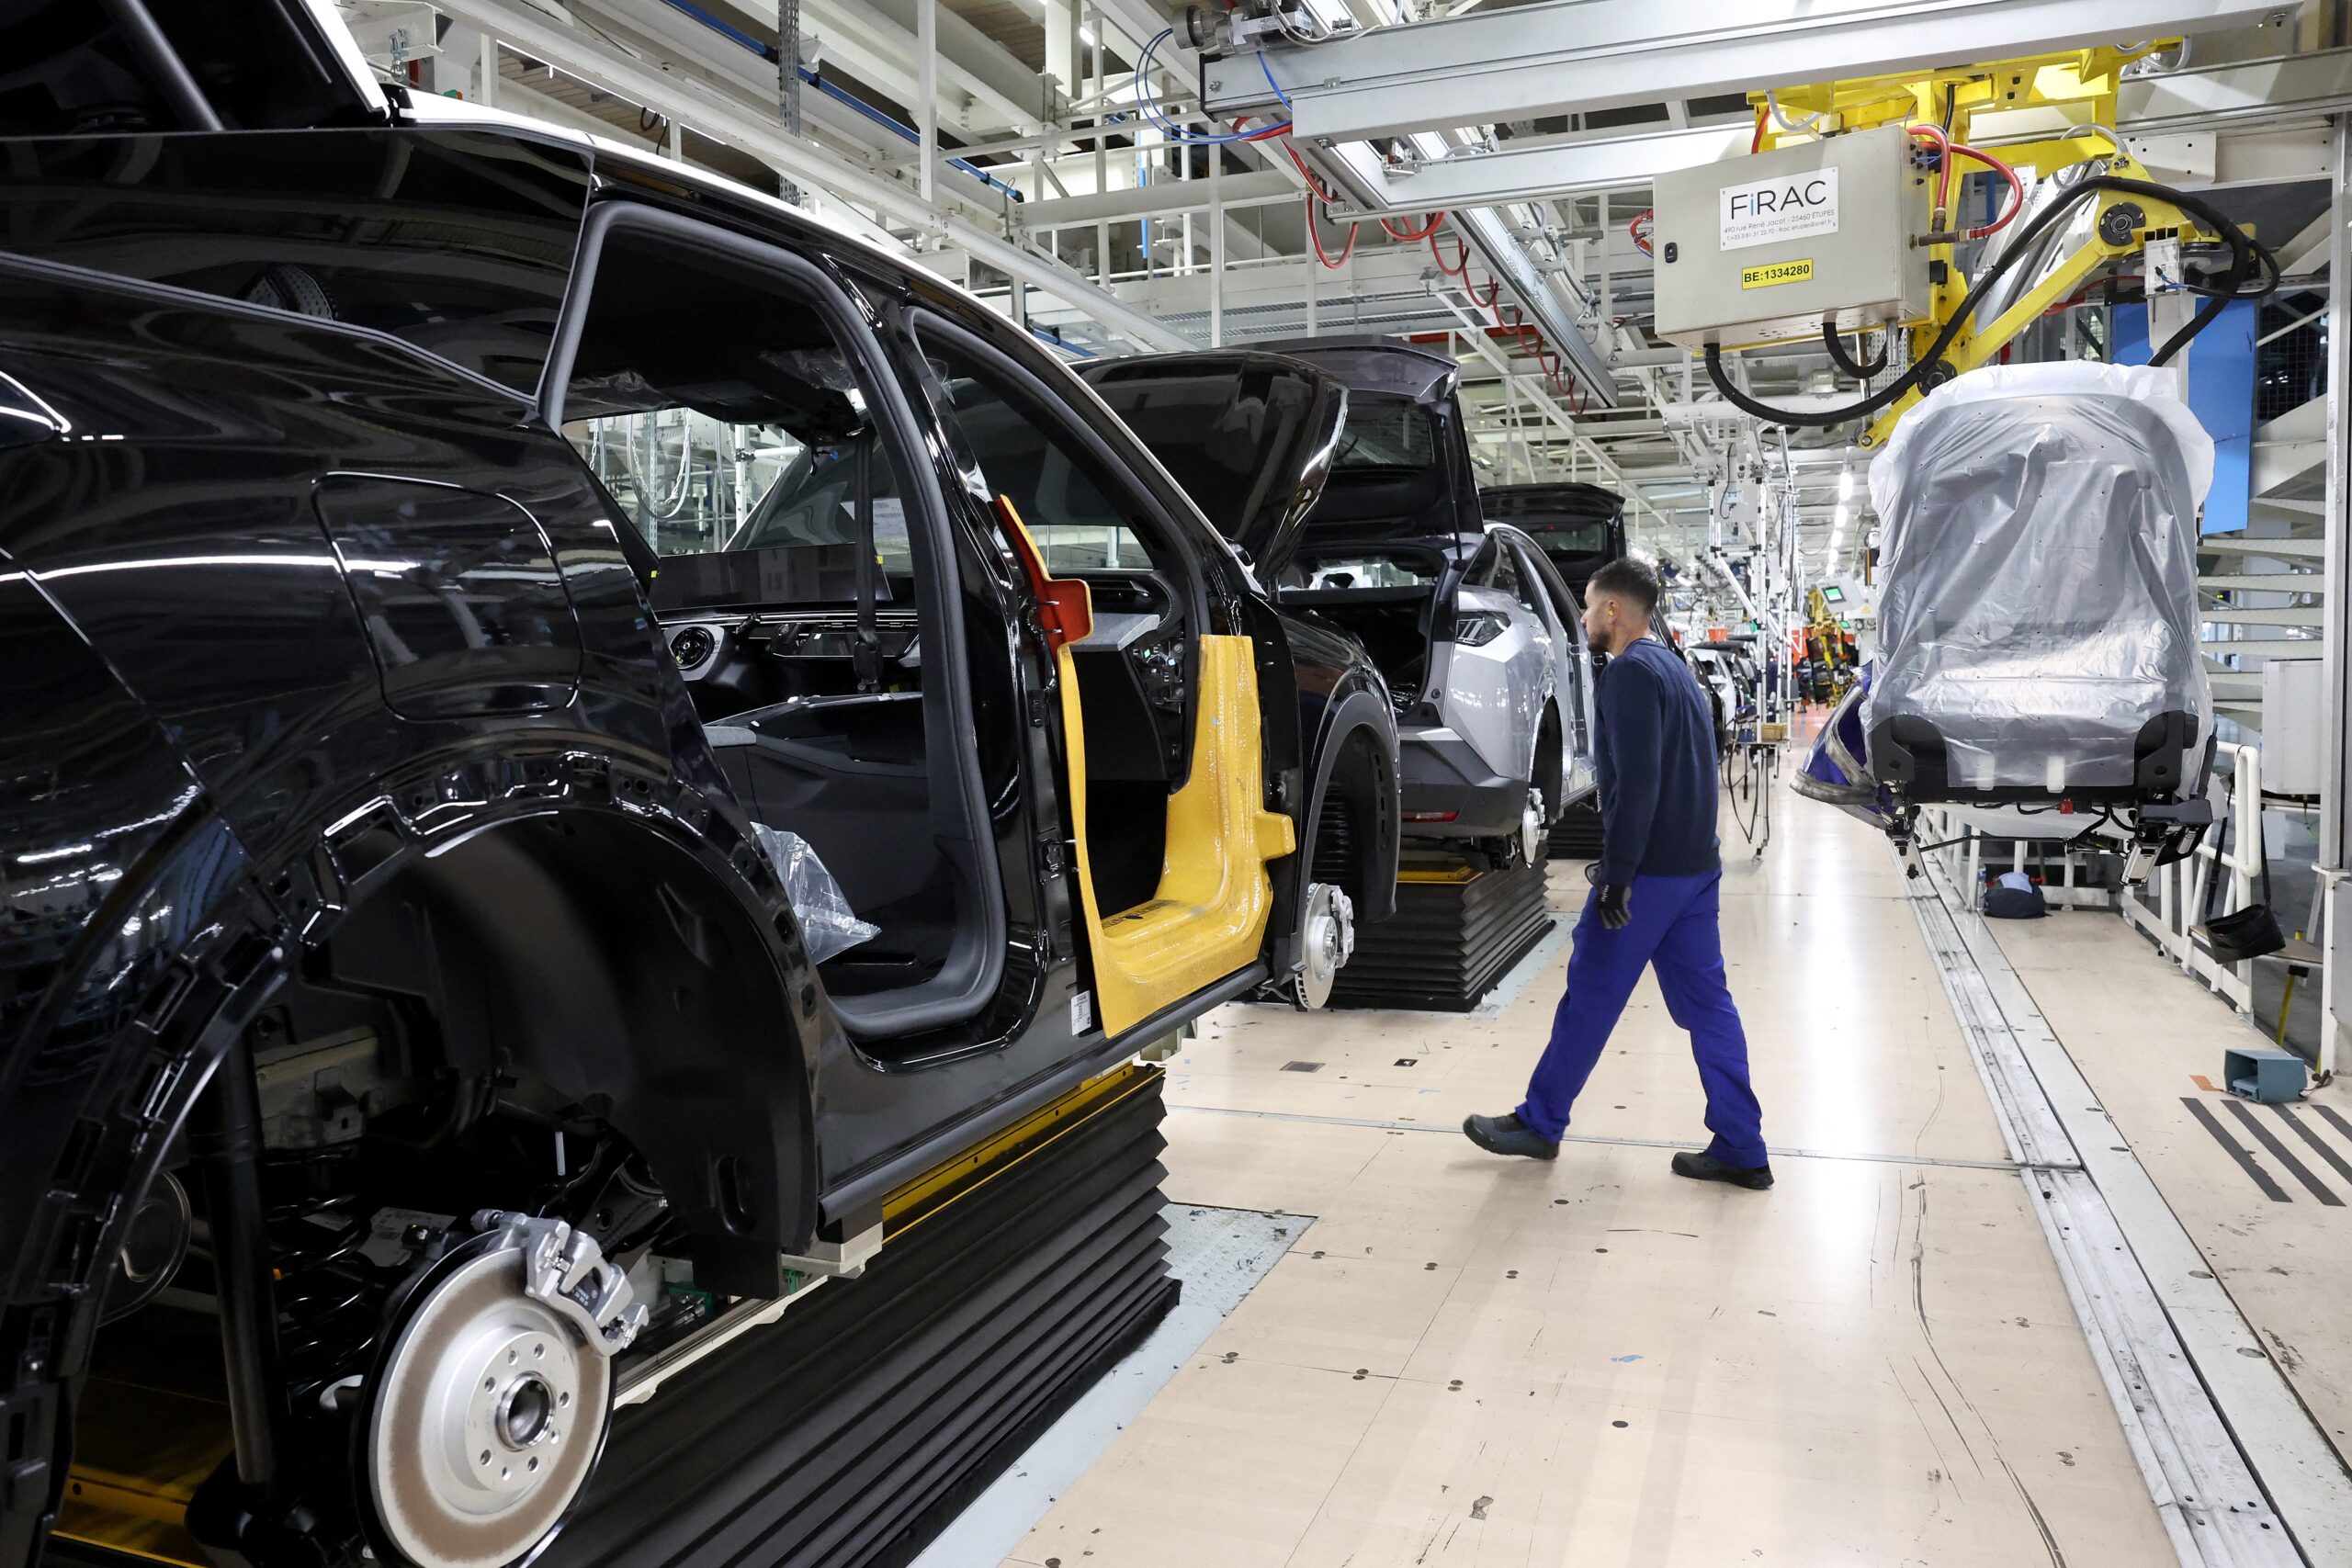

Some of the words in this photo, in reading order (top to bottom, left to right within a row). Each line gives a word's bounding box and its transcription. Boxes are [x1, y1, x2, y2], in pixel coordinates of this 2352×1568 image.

[1748, 220, 1765, 229] René
[1767, 218, 1786, 227] Jacot
[1744, 264, 1810, 283] BE:1334280
